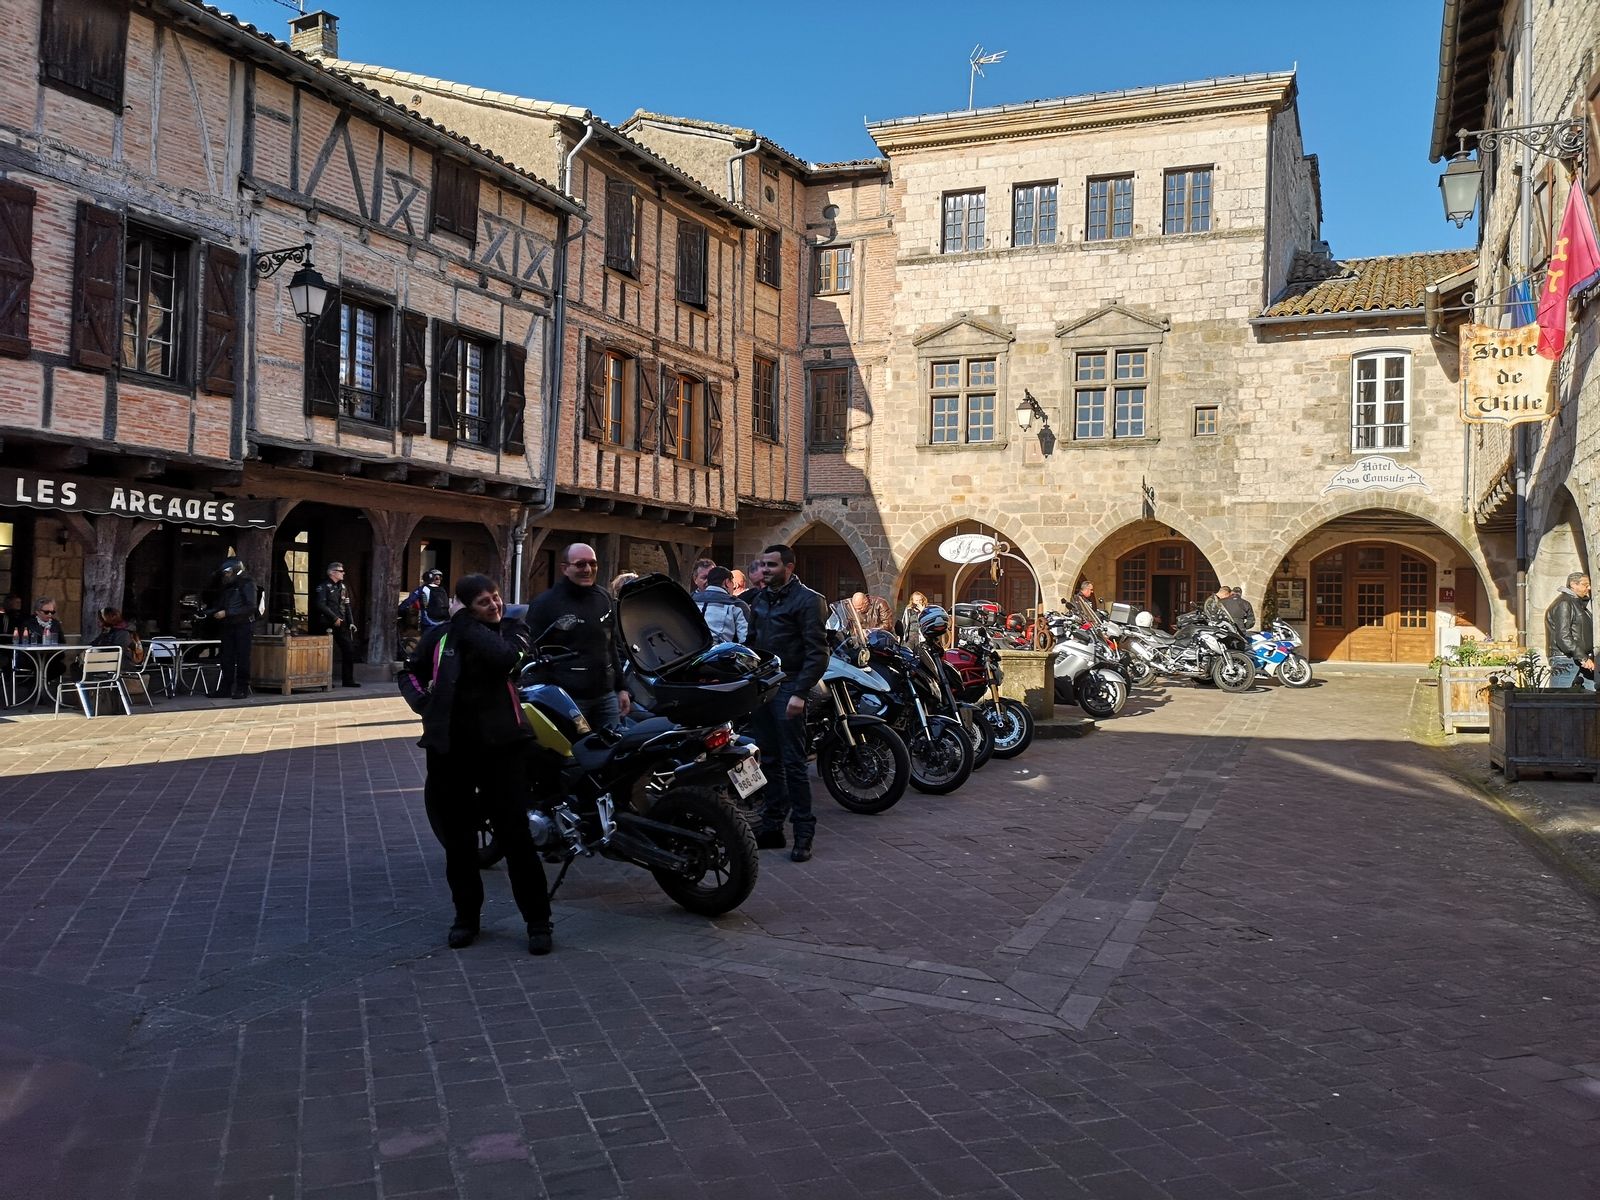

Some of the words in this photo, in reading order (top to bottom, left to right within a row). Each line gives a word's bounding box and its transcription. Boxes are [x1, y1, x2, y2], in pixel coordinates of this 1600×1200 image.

[1472, 342, 1538, 361] Hote
[1496, 368, 1523, 385] de
[1473, 394, 1543, 413] Ville
[1361, 462, 1391, 471] Hôtel
[1346, 477, 1360, 485] des
[1362, 473, 1405, 483] Consuls
[16, 477, 77, 506] LES
[110, 487, 235, 522] ARCADES
